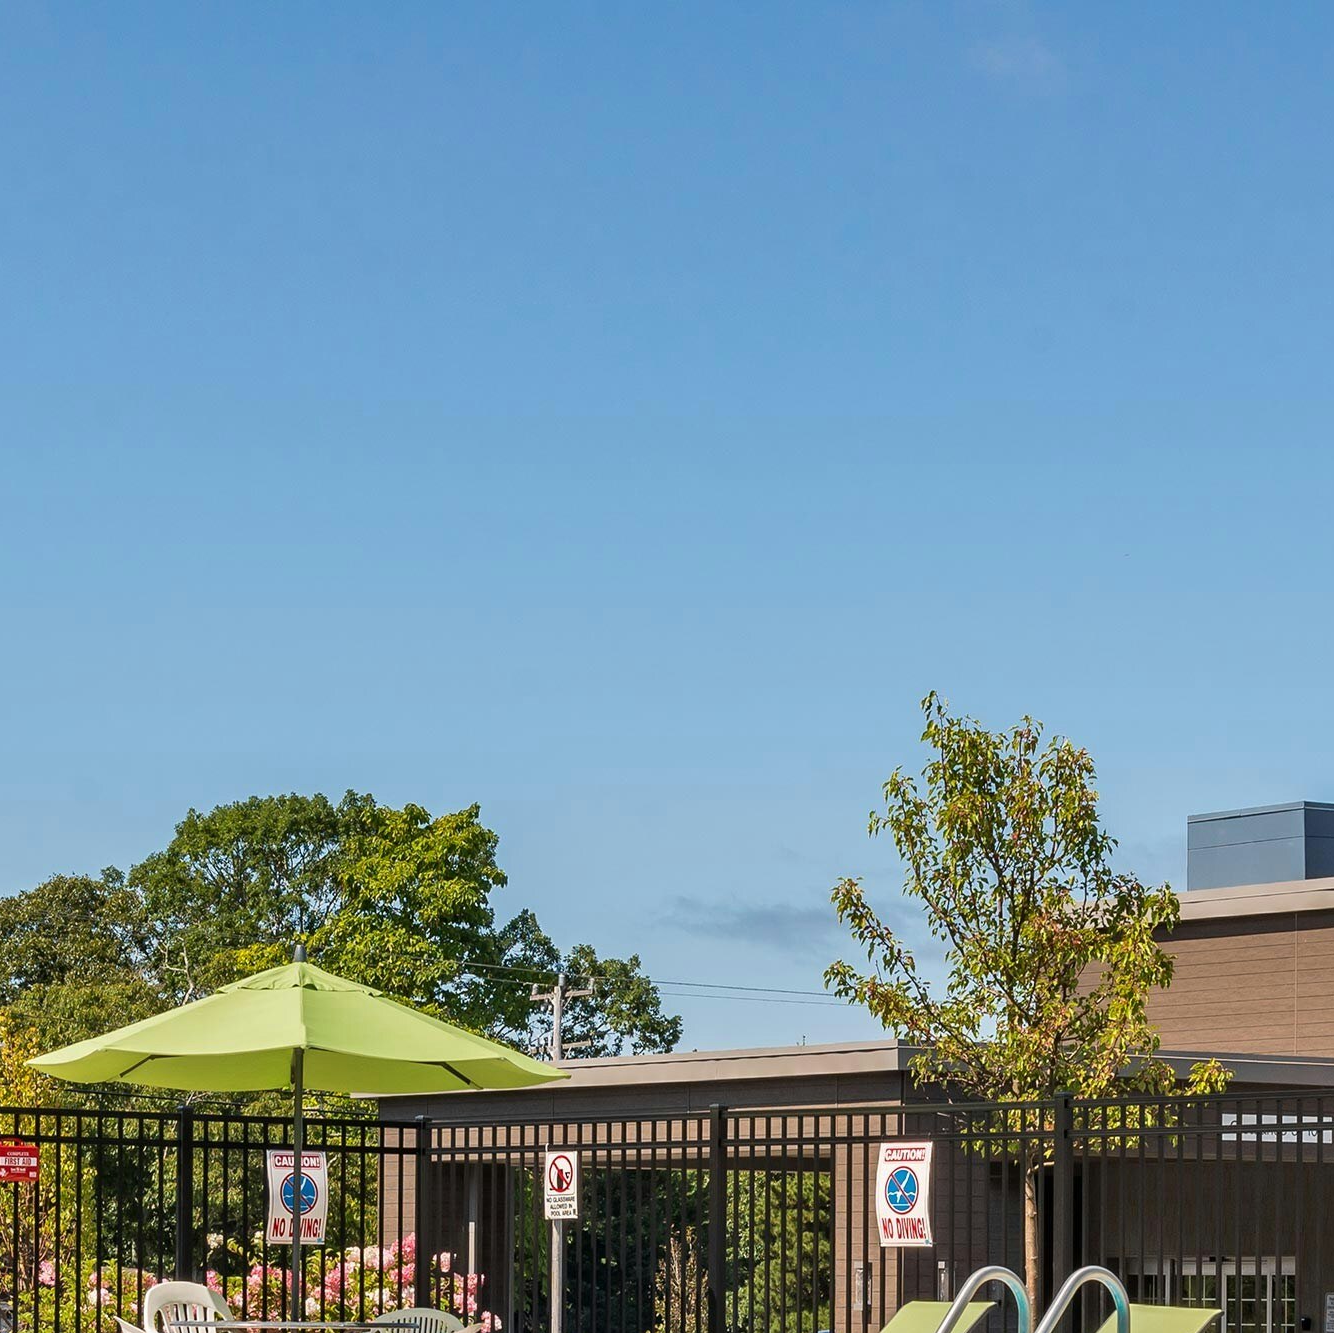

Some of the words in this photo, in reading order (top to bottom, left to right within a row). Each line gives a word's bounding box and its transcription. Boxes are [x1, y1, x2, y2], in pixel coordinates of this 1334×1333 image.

[275, 1155, 320, 1167] CAUON!
[885, 1149, 926, 1161] CAUTION!
[5, 1158, 21, 1166] FIRST
[22, 1158, 32, 1166] AID
[271, 1217, 286, 1237] NO
[289, 1217, 322, 1238] DVING!
[881, 1217, 894, 1239] NO
[895, 1217, 927, 1239] DIVING!
